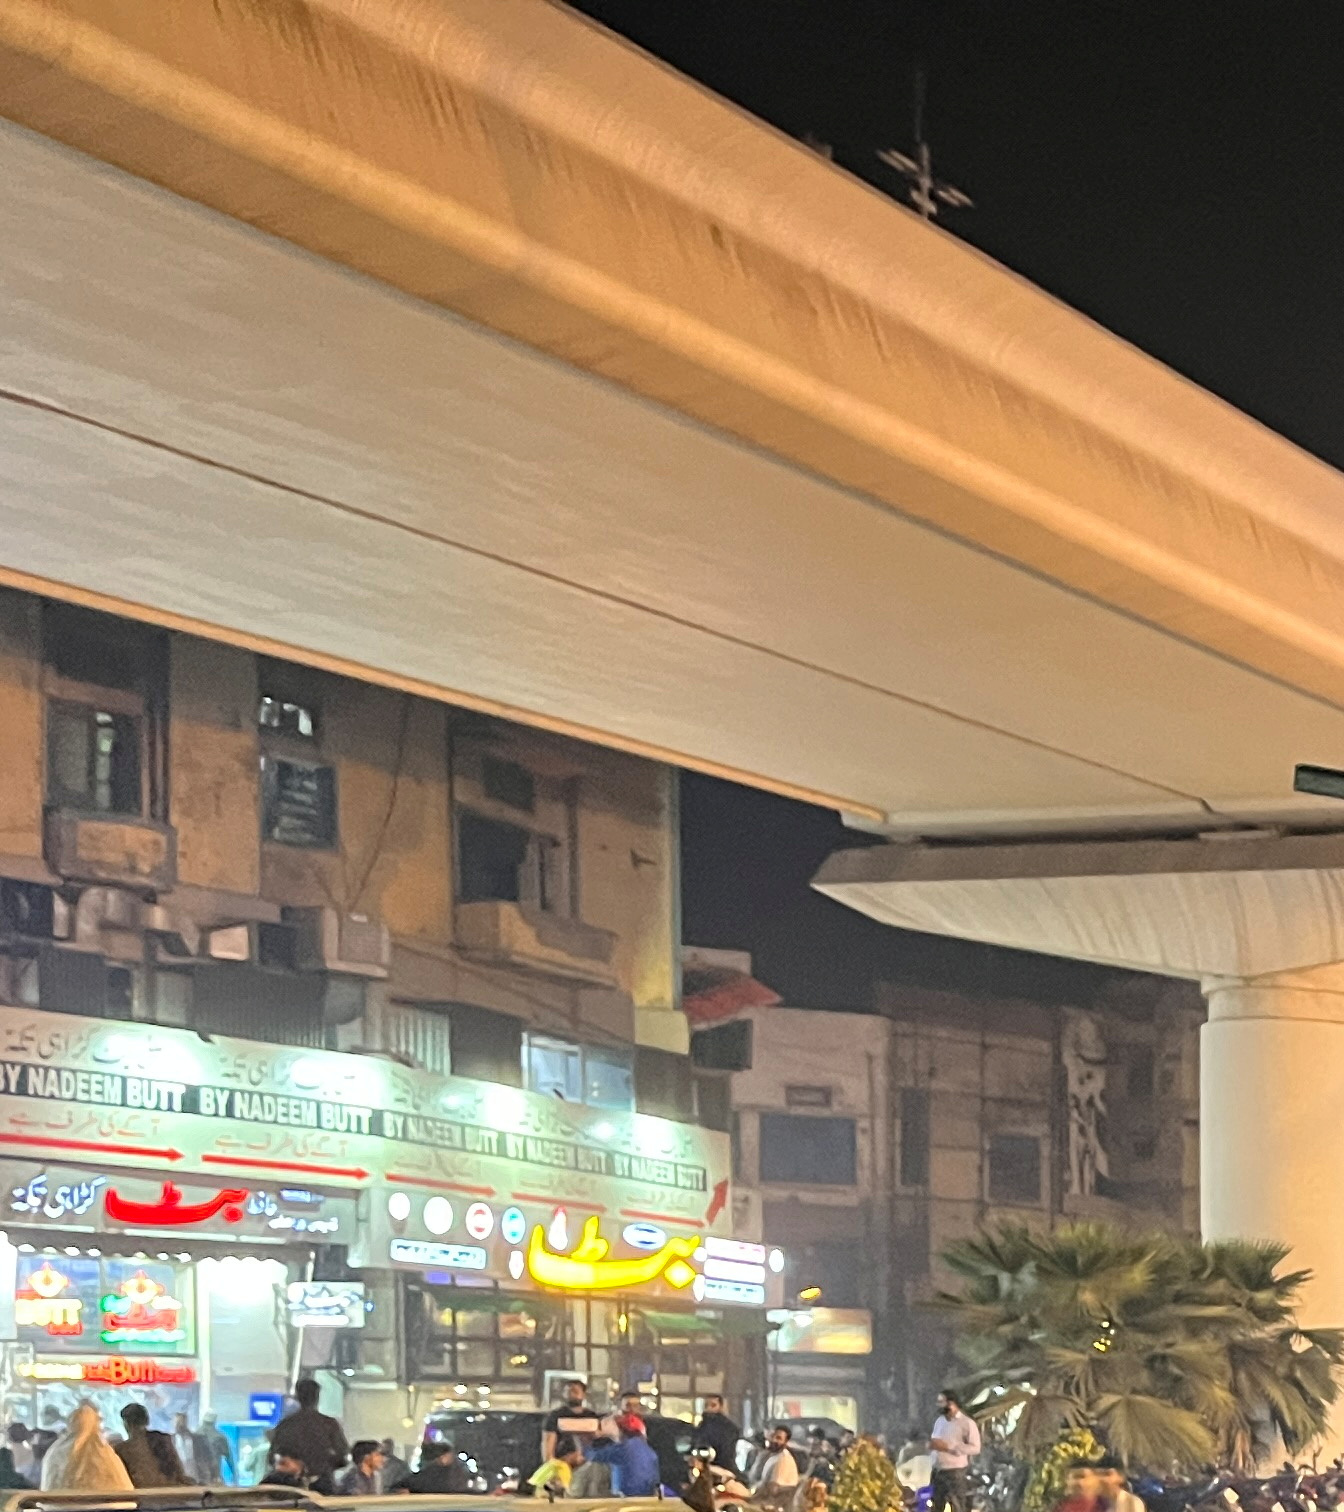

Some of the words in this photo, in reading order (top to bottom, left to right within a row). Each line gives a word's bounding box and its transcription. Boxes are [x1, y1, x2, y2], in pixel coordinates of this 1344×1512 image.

[0, 1062, 21, 1093] Y
[27, 1066, 122, 1106] NADEEM
[126, 1077, 186, 1112] BUTT
[201, 1087, 230, 1117] BY
[234, 1091, 317, 1127] NADEEM
[320, 1102, 372, 1134] BUTT
[105, 1180, 249, 1225] بٹ
[528, 1215, 700, 1289] بٹ
